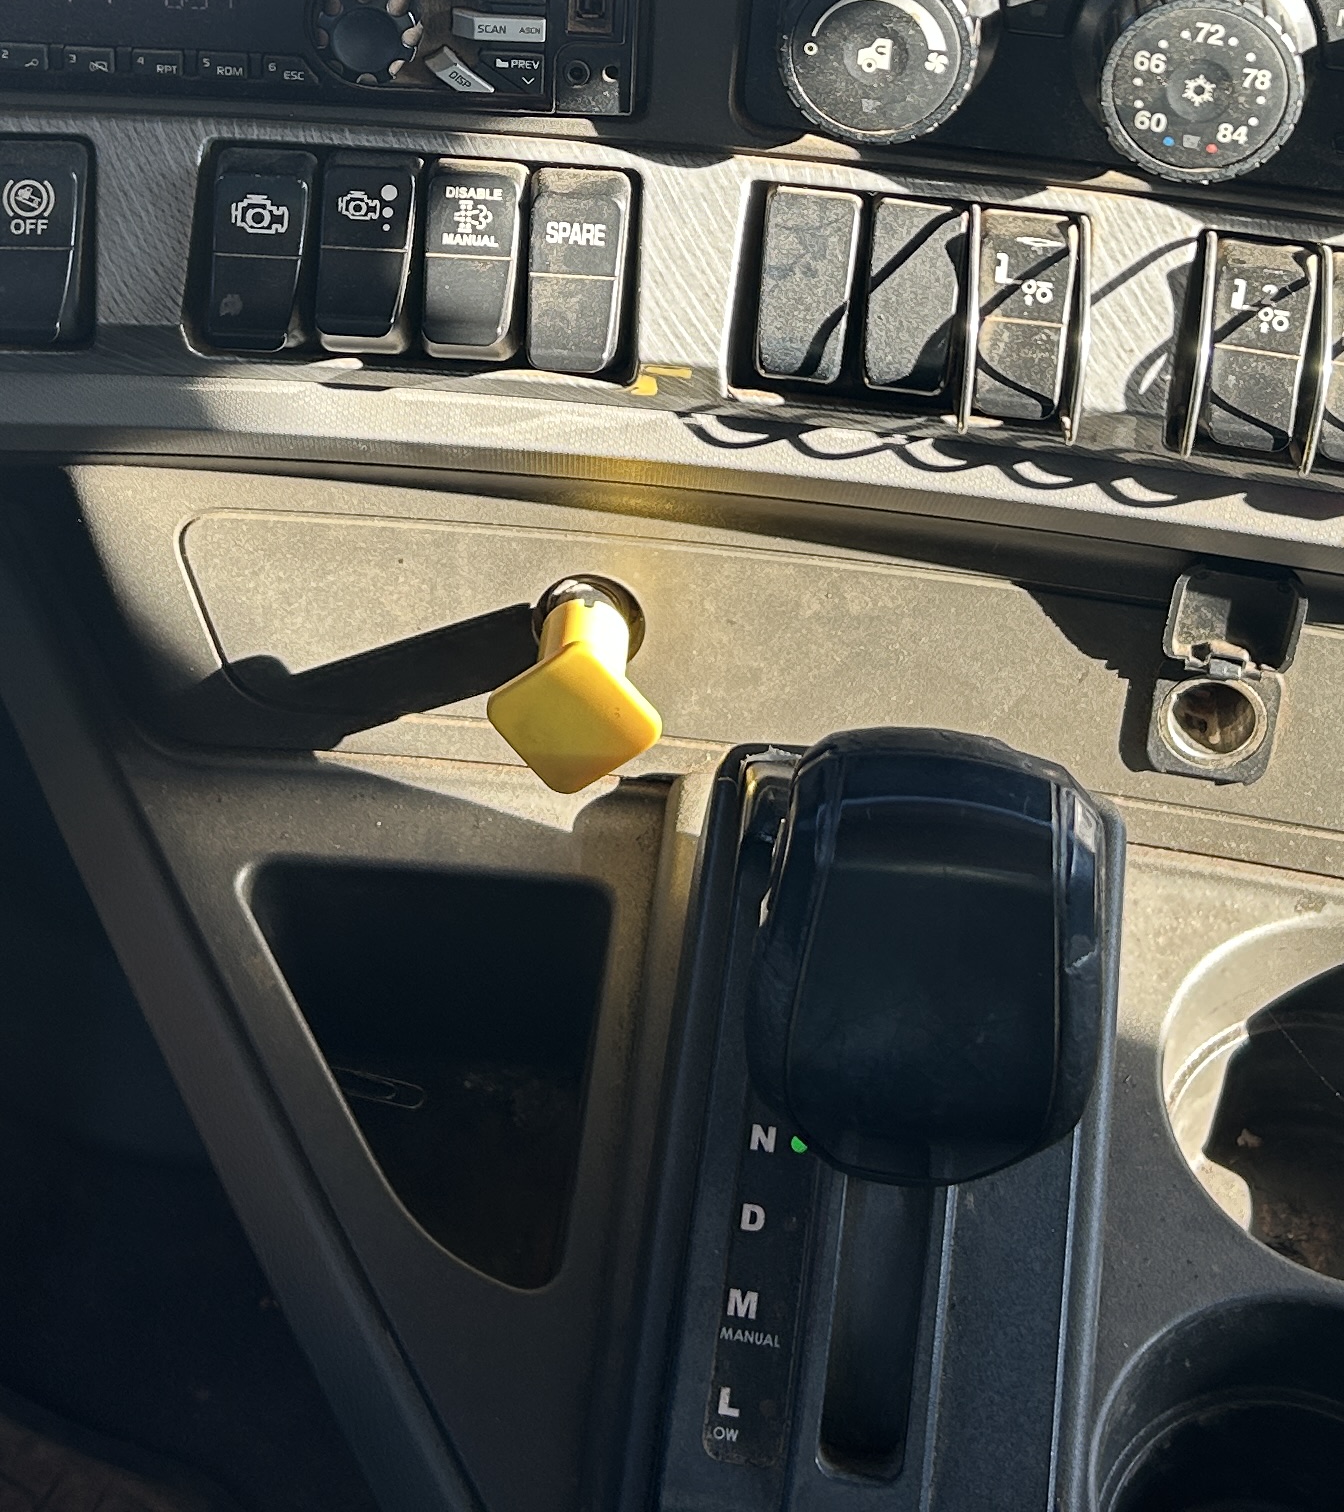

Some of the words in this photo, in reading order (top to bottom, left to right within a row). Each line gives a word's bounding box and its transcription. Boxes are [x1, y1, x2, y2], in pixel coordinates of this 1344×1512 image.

[477, 24, 506, 34] SCAN
[1193, 21, 1225, 47] 72
[1, 49, 9, 59] 2
[69, 54, 77, 63] 3
[1133, 50, 1167, 75] 66
[136, 56, 144, 65] 4
[156, 64, 178, 74] RPT
[203, 58, 210, 67] 5
[217, 66, 243, 77] RDM
[268, 62, 276, 72] 6
[283, 70, 305, 81] ESC
[511, 59, 540, 70] PREV
[448, 71, 472, 88] DISP
[1241, 67, 1272, 91] 78
[1133, 109, 1168, 133] 60
[1216, 122, 1248, 145] 84
[445, 186, 503, 201] DISABLE
[10, 219, 49, 235] OFF
[545, 221, 606, 247] SPARE
[442, 233, 499, 248] MANUAL
[749, 1123, 777, 1153] N
[740, 1203, 766, 1232] D
[726, 1288, 758, 1319] M
[719, 1326, 781, 1349] MANUAL
[717, 1386, 740, 1418] L
[711, 1426, 740, 1442] OW
